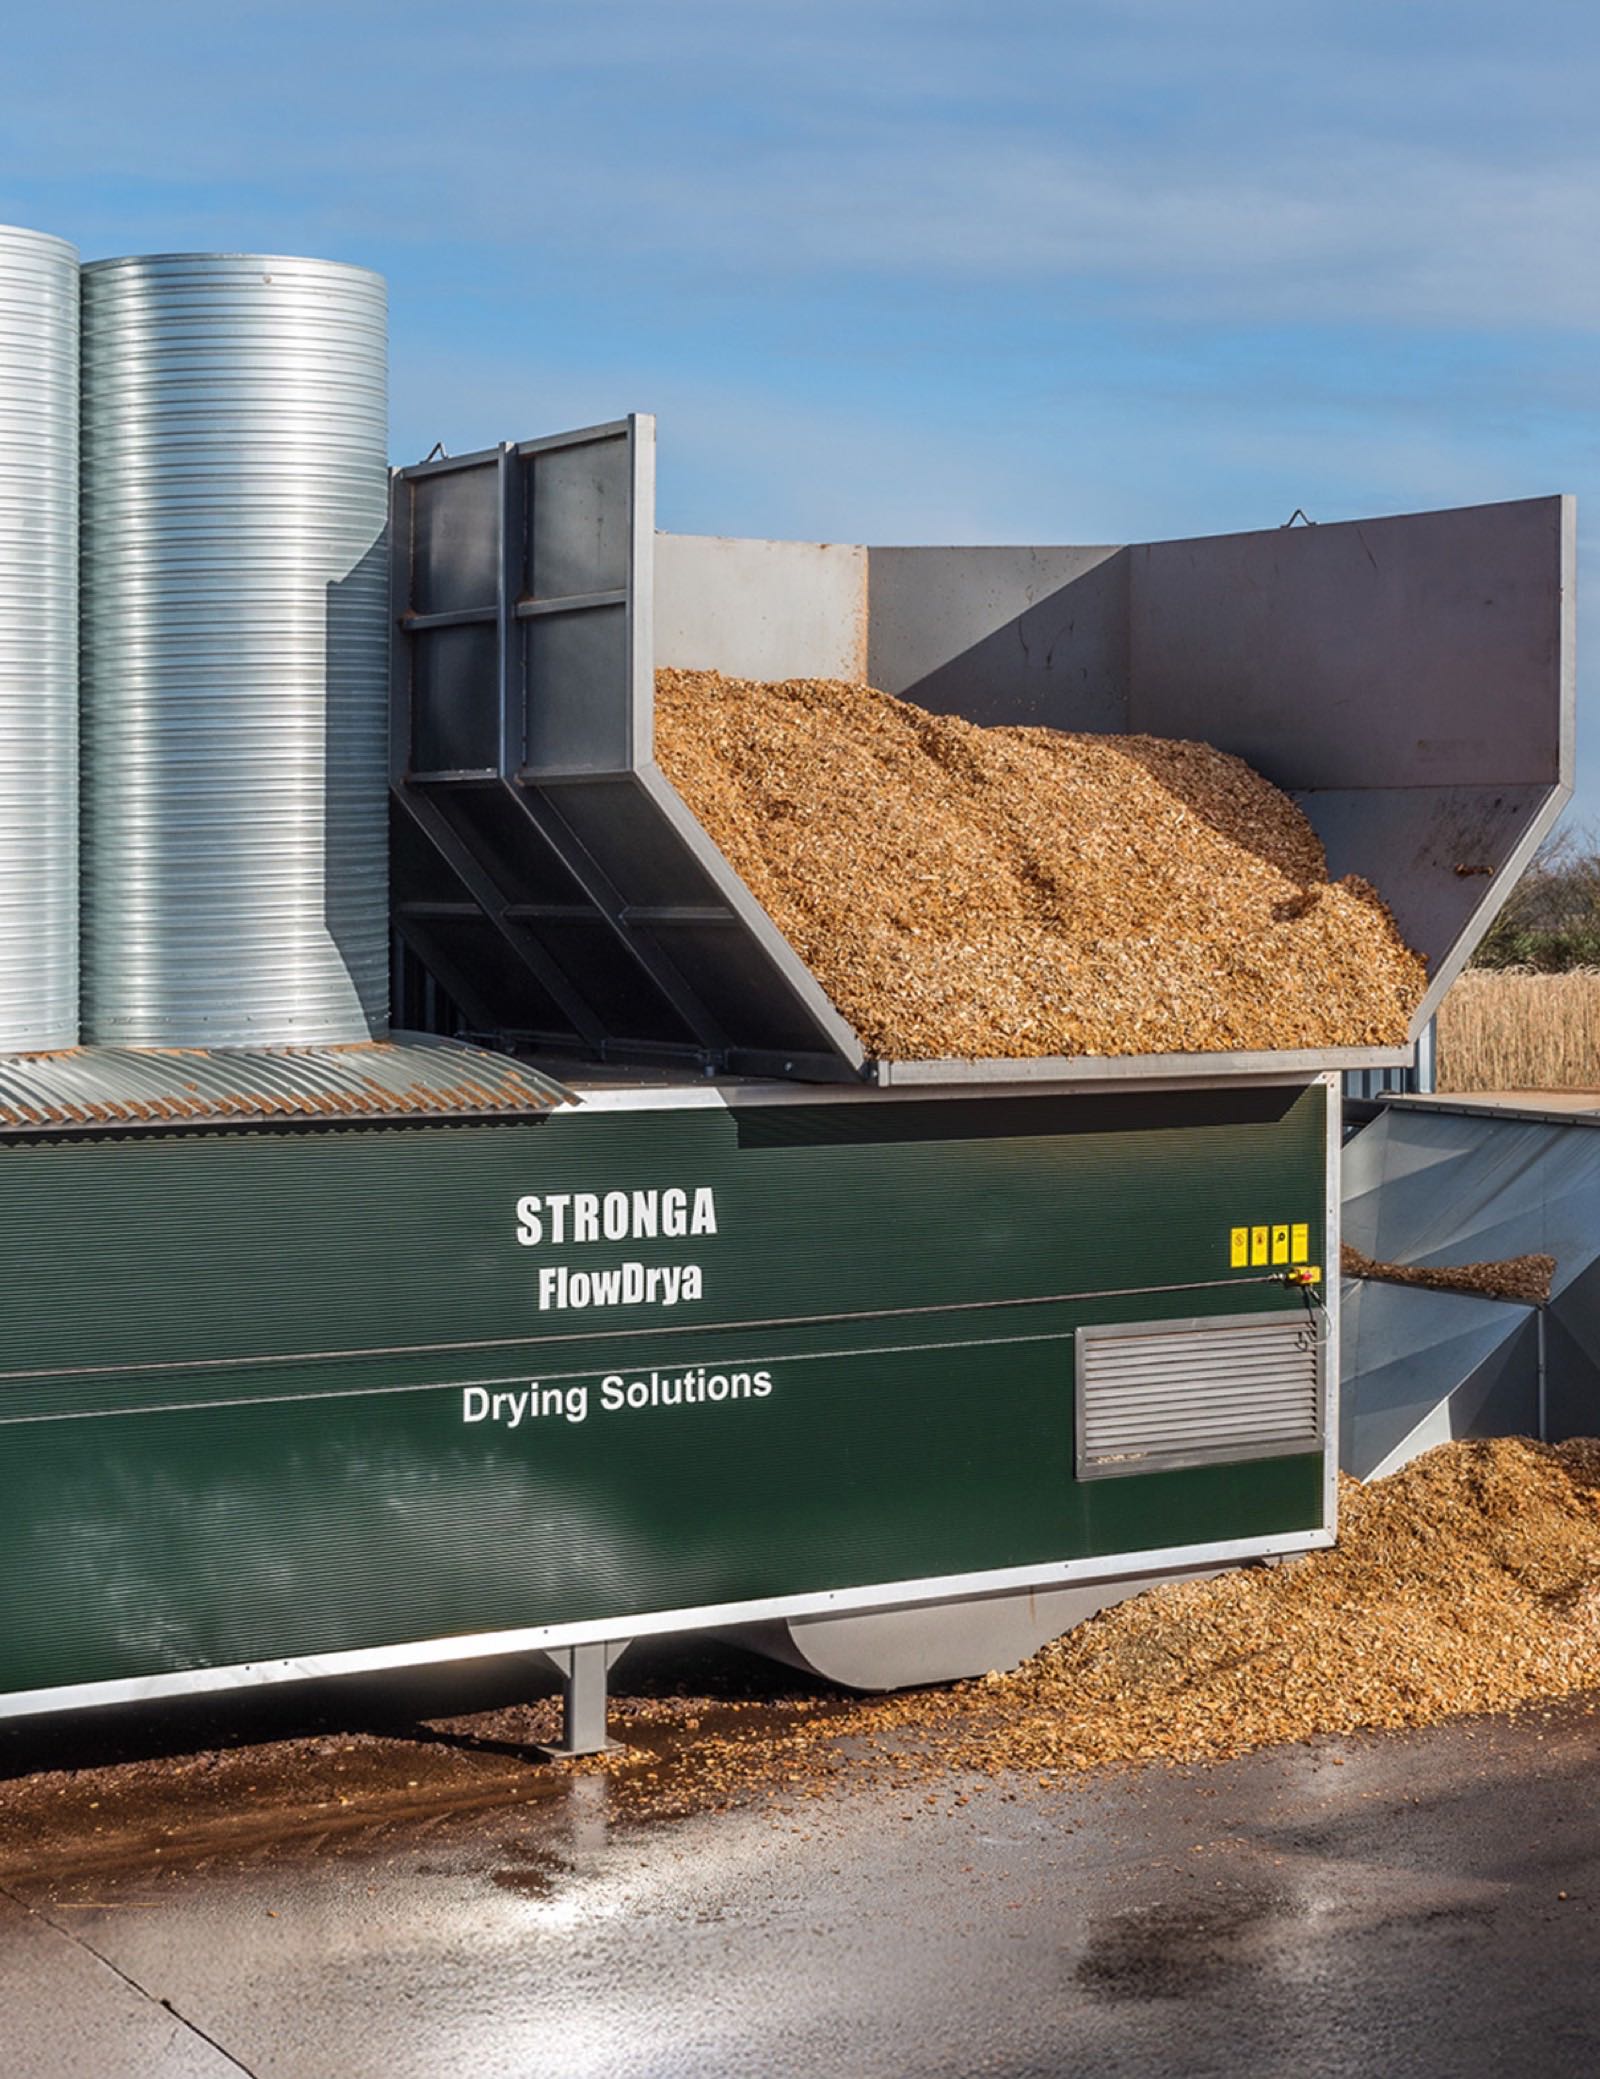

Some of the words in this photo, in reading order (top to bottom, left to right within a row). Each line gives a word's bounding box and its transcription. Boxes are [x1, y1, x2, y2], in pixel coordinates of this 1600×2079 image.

[516, 1187, 717, 1246] STRONGA
[539, 1262, 702, 1310] FlowDrya
[463, 1382, 587, 1428] Drying
[601, 1368, 772, 1410] Solutions
